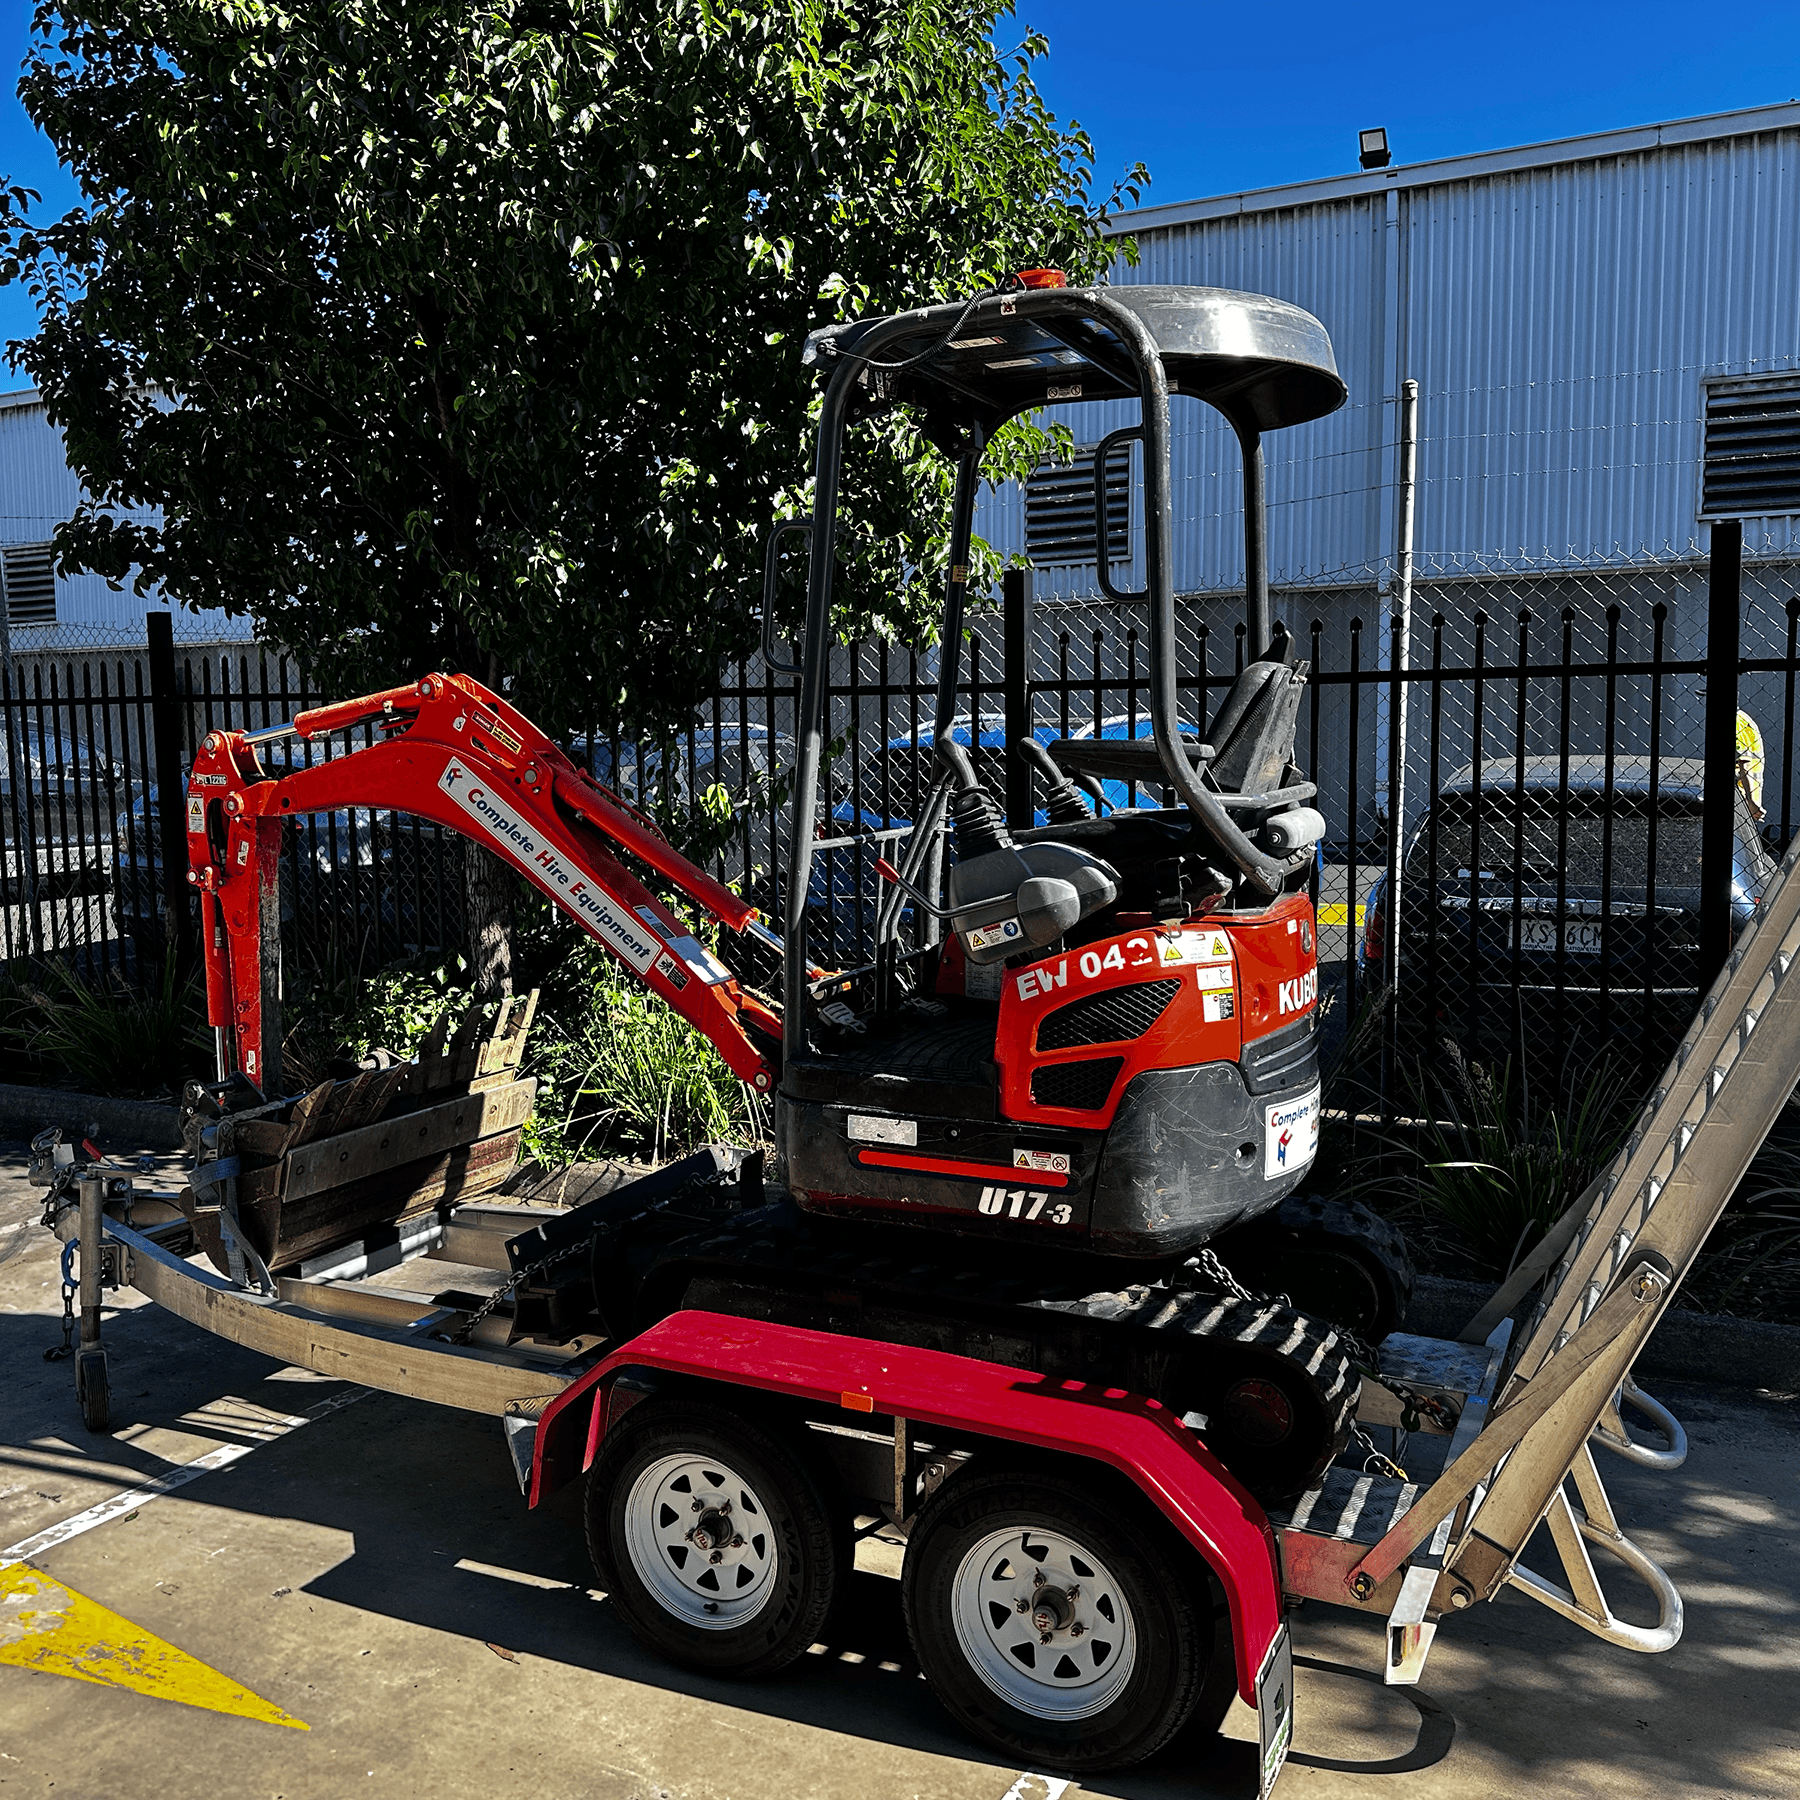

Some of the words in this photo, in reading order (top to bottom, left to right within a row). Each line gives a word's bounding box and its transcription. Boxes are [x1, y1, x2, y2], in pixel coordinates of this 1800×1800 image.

[467, 788, 535, 853] Complete
[534, 849, 569, 885] Hire
[568, 880, 651, 959] Equipment
[1016, 960, 1067, 1001] EW
[1271, 1106, 1309, 1127] Complete
[977, 1186, 1073, 1225] U17-3
[765, 1517, 801, 1645] WANLI
